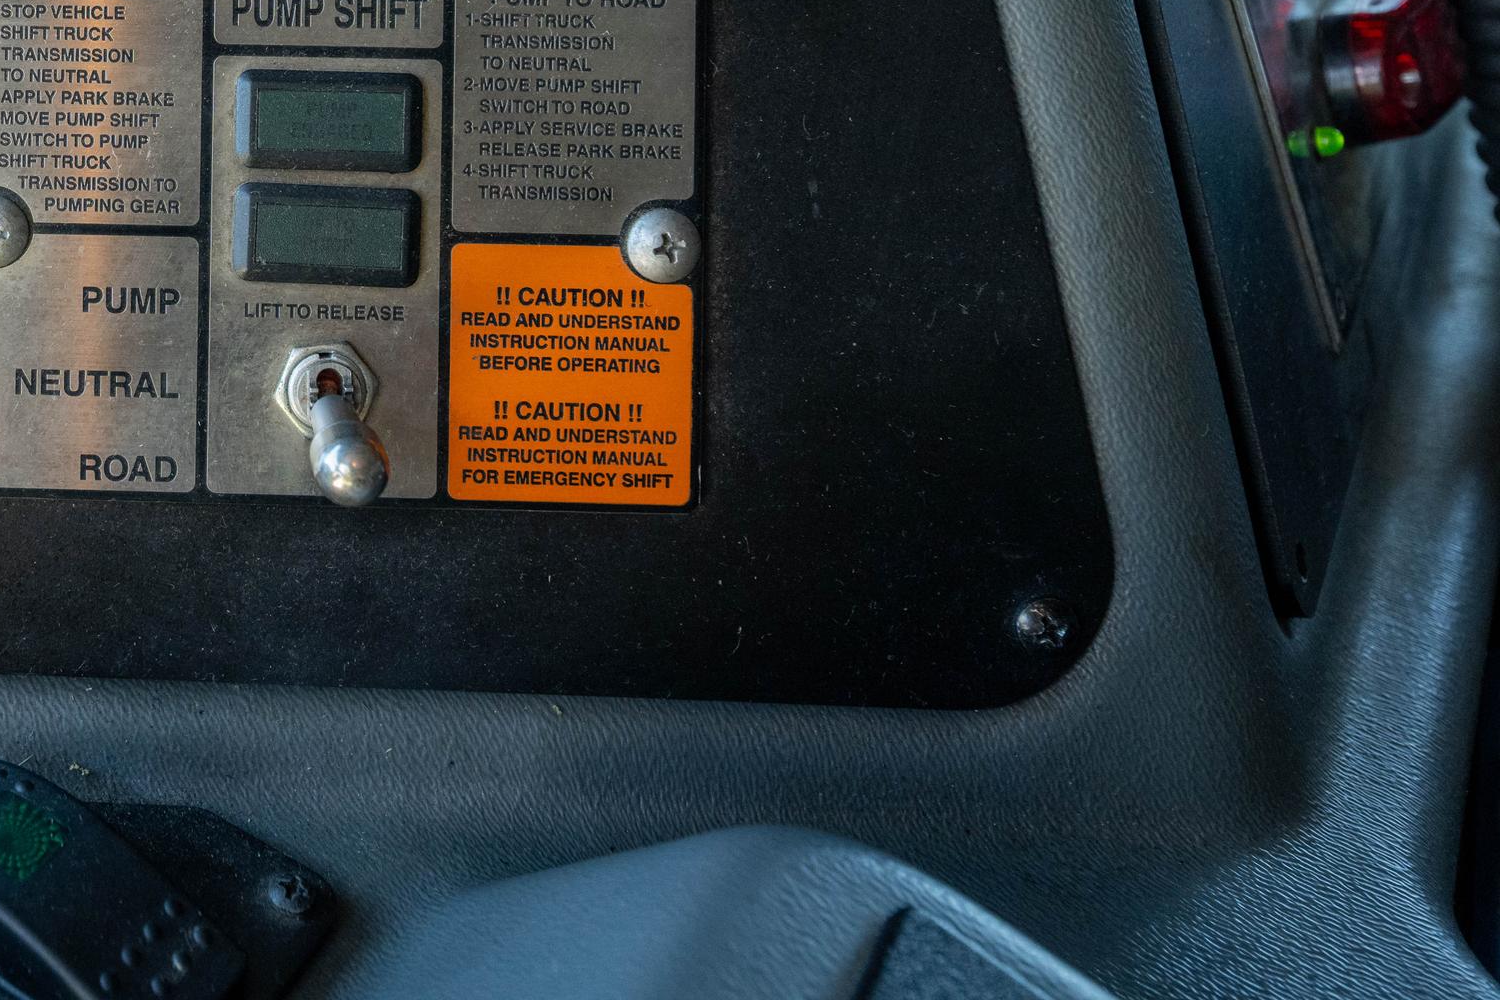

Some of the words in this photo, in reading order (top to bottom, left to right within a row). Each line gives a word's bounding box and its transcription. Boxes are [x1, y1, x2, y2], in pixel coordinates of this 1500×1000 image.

[51, 5, 126, 20] VEHICLE
[465, 13, 530, 28] 1-SHIFT
[536, 14, 596, 29] TRUCK
[53, 26, 114, 42] TRUCK
[481, 34, 616, 51] TRANSMISSION
[1, 46, 135, 63] TRANSMISSION
[480, 56, 503, 70] TO
[508, 56, 592, 72] NEUTRAL
[1, 68, 23, 83] TO
[29, 68, 112, 84] NEUTRAL
[463, 78, 530, 92] 2-MOVE
[535, 79, 586, 94] PUMP
[591, 80, 642, 95] SHIFT
[61, 90, 108, 106] PARK
[113, 91, 175, 107] BRAKE
[479, 100, 548, 115] SWITCH
[552, 100, 575, 115] TO
[580, 101, 631, 116] ROAD
[55, 112, 105, 127] PUMP
[110, 112, 161, 128] SHIFT
[463, 120, 535, 135] 3-APPLY
[540, 121, 617, 137] SERVICE
[622, 122, 684, 138] BRAKE
[0, 132, 68, 147] SWITCH
[71, 133, 94, 148] TO
[99, 134, 149, 149] PUMP
[478, 142, 561, 157] RELEASE
[567, 143, 615, 158] PARK
[619, 144, 682, 160] BRAKE
[51, 154, 111, 170] TRUCK
[462, 163, 529, 179] 4-SHIFT
[534, 164, 594, 180] TRUCK
[18, 175, 150, 192] TRANSMISSION
[154, 178, 177, 192] TO
[478, 185, 613, 201] TRANSMISSION
[44, 197, 125, 213] PUMPING
[130, 198, 180, 214] GEAR
[82, 286, 181, 314] PUMP
[518, 287, 623, 308] CAUTION
[244, 302, 283, 319] LIFT
[286, 303, 312, 319] TO
[317, 304, 404, 322] RELEASE
[461, 312, 511, 327] READ
[515, 313, 554, 328] AND
[559, 314, 681, 331] UNDERSTAND
[470, 334, 590, 351] INSTRUCTION
[595, 337, 670, 352] MANUAL
[479, 355, 552, 371] BEFORE
[557, 357, 660, 374] OPERATING
[14, 368, 180, 399] NEUTRAL
[515, 401, 620, 422] CAUTION
[458, 426, 508, 441] READ
[513, 427, 551, 442] AND
[556, 428, 677, 445] UNDERSTAND
[467, 448, 587, 465] INSTRUCTION
[592, 451, 668, 467] MANUAL
[79, 454, 178, 483] ROAD
[462, 469, 499, 484] FOR
[504, 470, 617, 487] EMERGENCY
[622, 473, 674, 489] SHIFT
